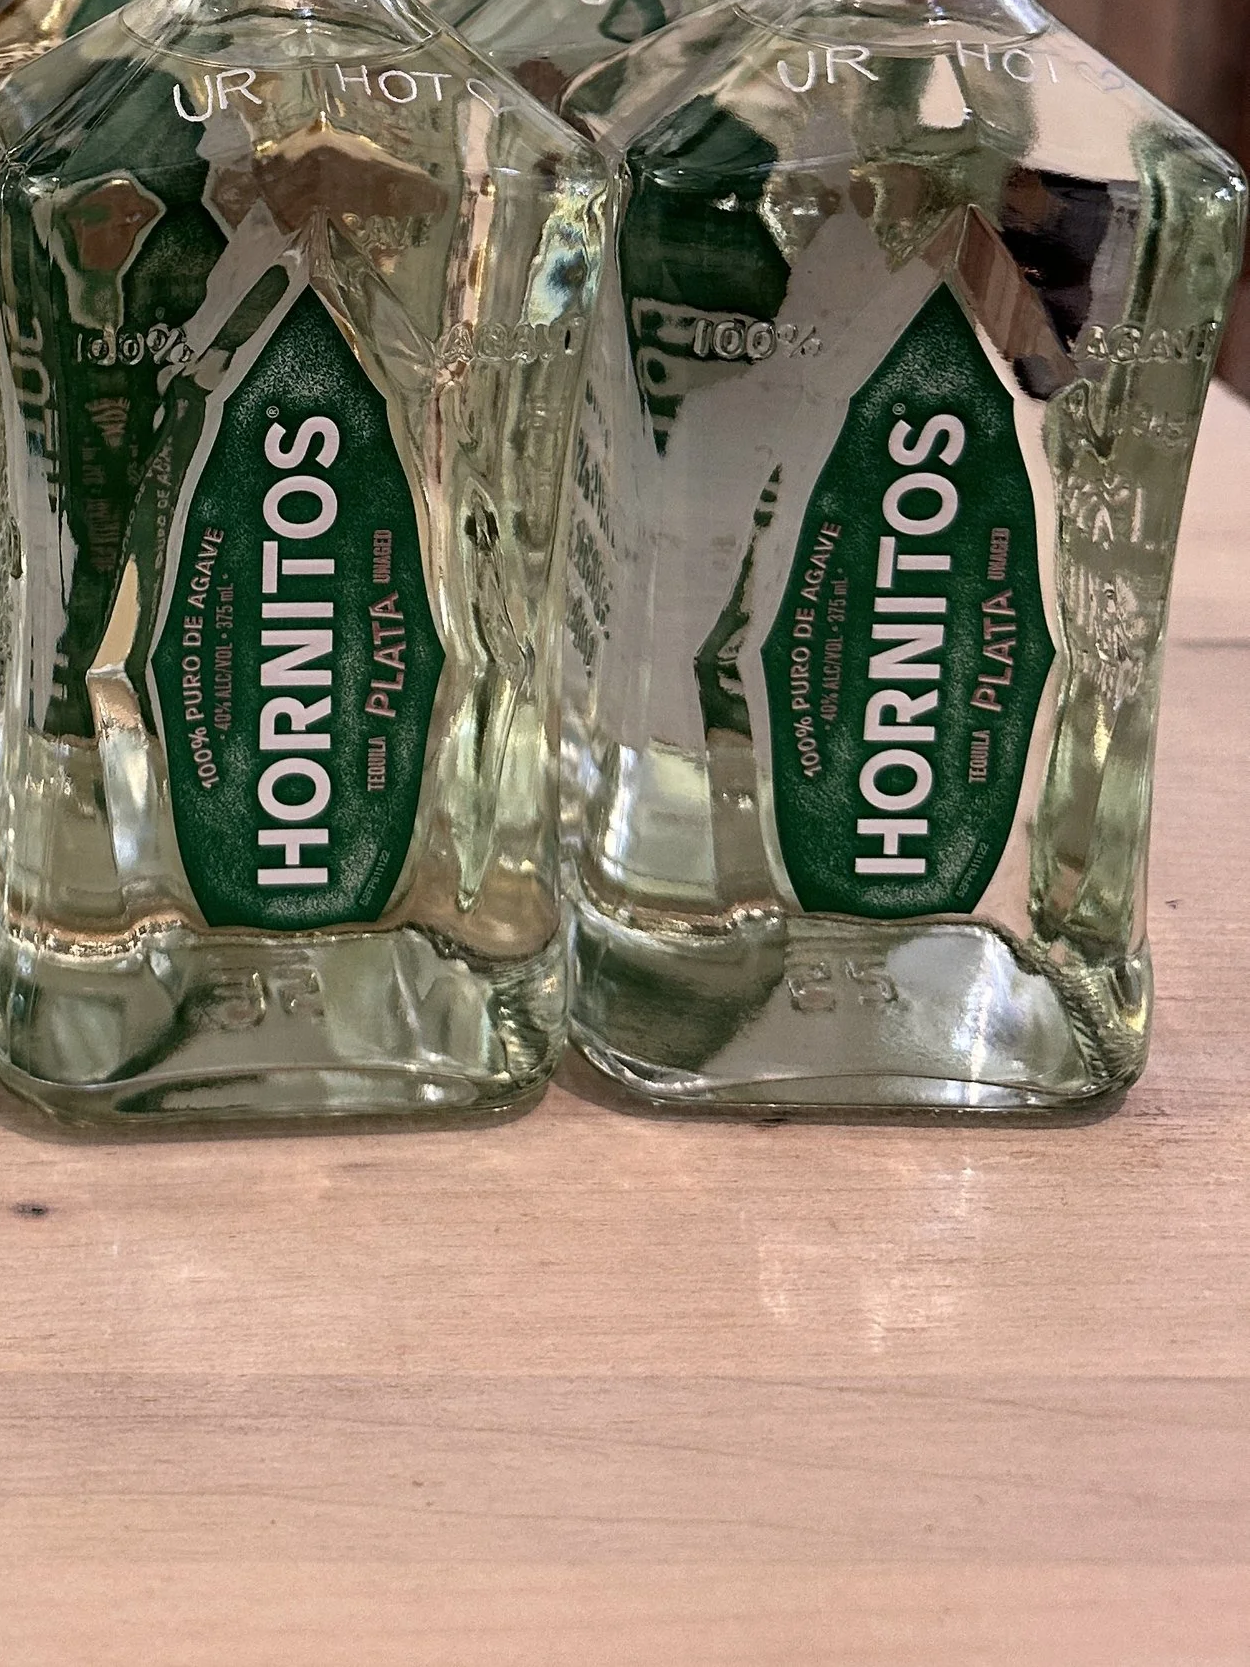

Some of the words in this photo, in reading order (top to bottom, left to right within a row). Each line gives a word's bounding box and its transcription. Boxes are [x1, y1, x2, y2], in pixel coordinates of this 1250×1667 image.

[172, 69, 262, 122] UR
[334, 63, 452, 103] HOT
[775, 44, 879, 93] UR
[956, 39, 1060, 84] HOT
[692, 318, 824, 360] 100%
[187, 526, 225, 609] AGAVE
[371, 528, 393, 585] UNAGED
[800, 521, 843, 602] AGAVE
[986, 526, 1011, 581] UNAGED
[215, 583, 234, 600] mL
[215, 604, 234, 630] 375
[826, 598, 846, 623] 375
[182, 615, 204, 647] DE
[792, 607, 815, 639] DE
[969, 586, 1017, 713] PLATA
[214, 642, 234, 700] ALC/VOL
[364, 588, 407, 719] PLATA
[790, 646, 811, 711] PURO
[822, 637, 843, 692] ALC/VOL
[181, 654, 205, 721] PURO
[214, 700, 232, 731] 40%
[820, 692, 839, 722] 40%
[188, 725, 221, 789] 100%
[367, 735, 387, 793] TEQUILA
[792, 716, 823, 778] 100%
[967, 728, 989, 785] TEQUILA
